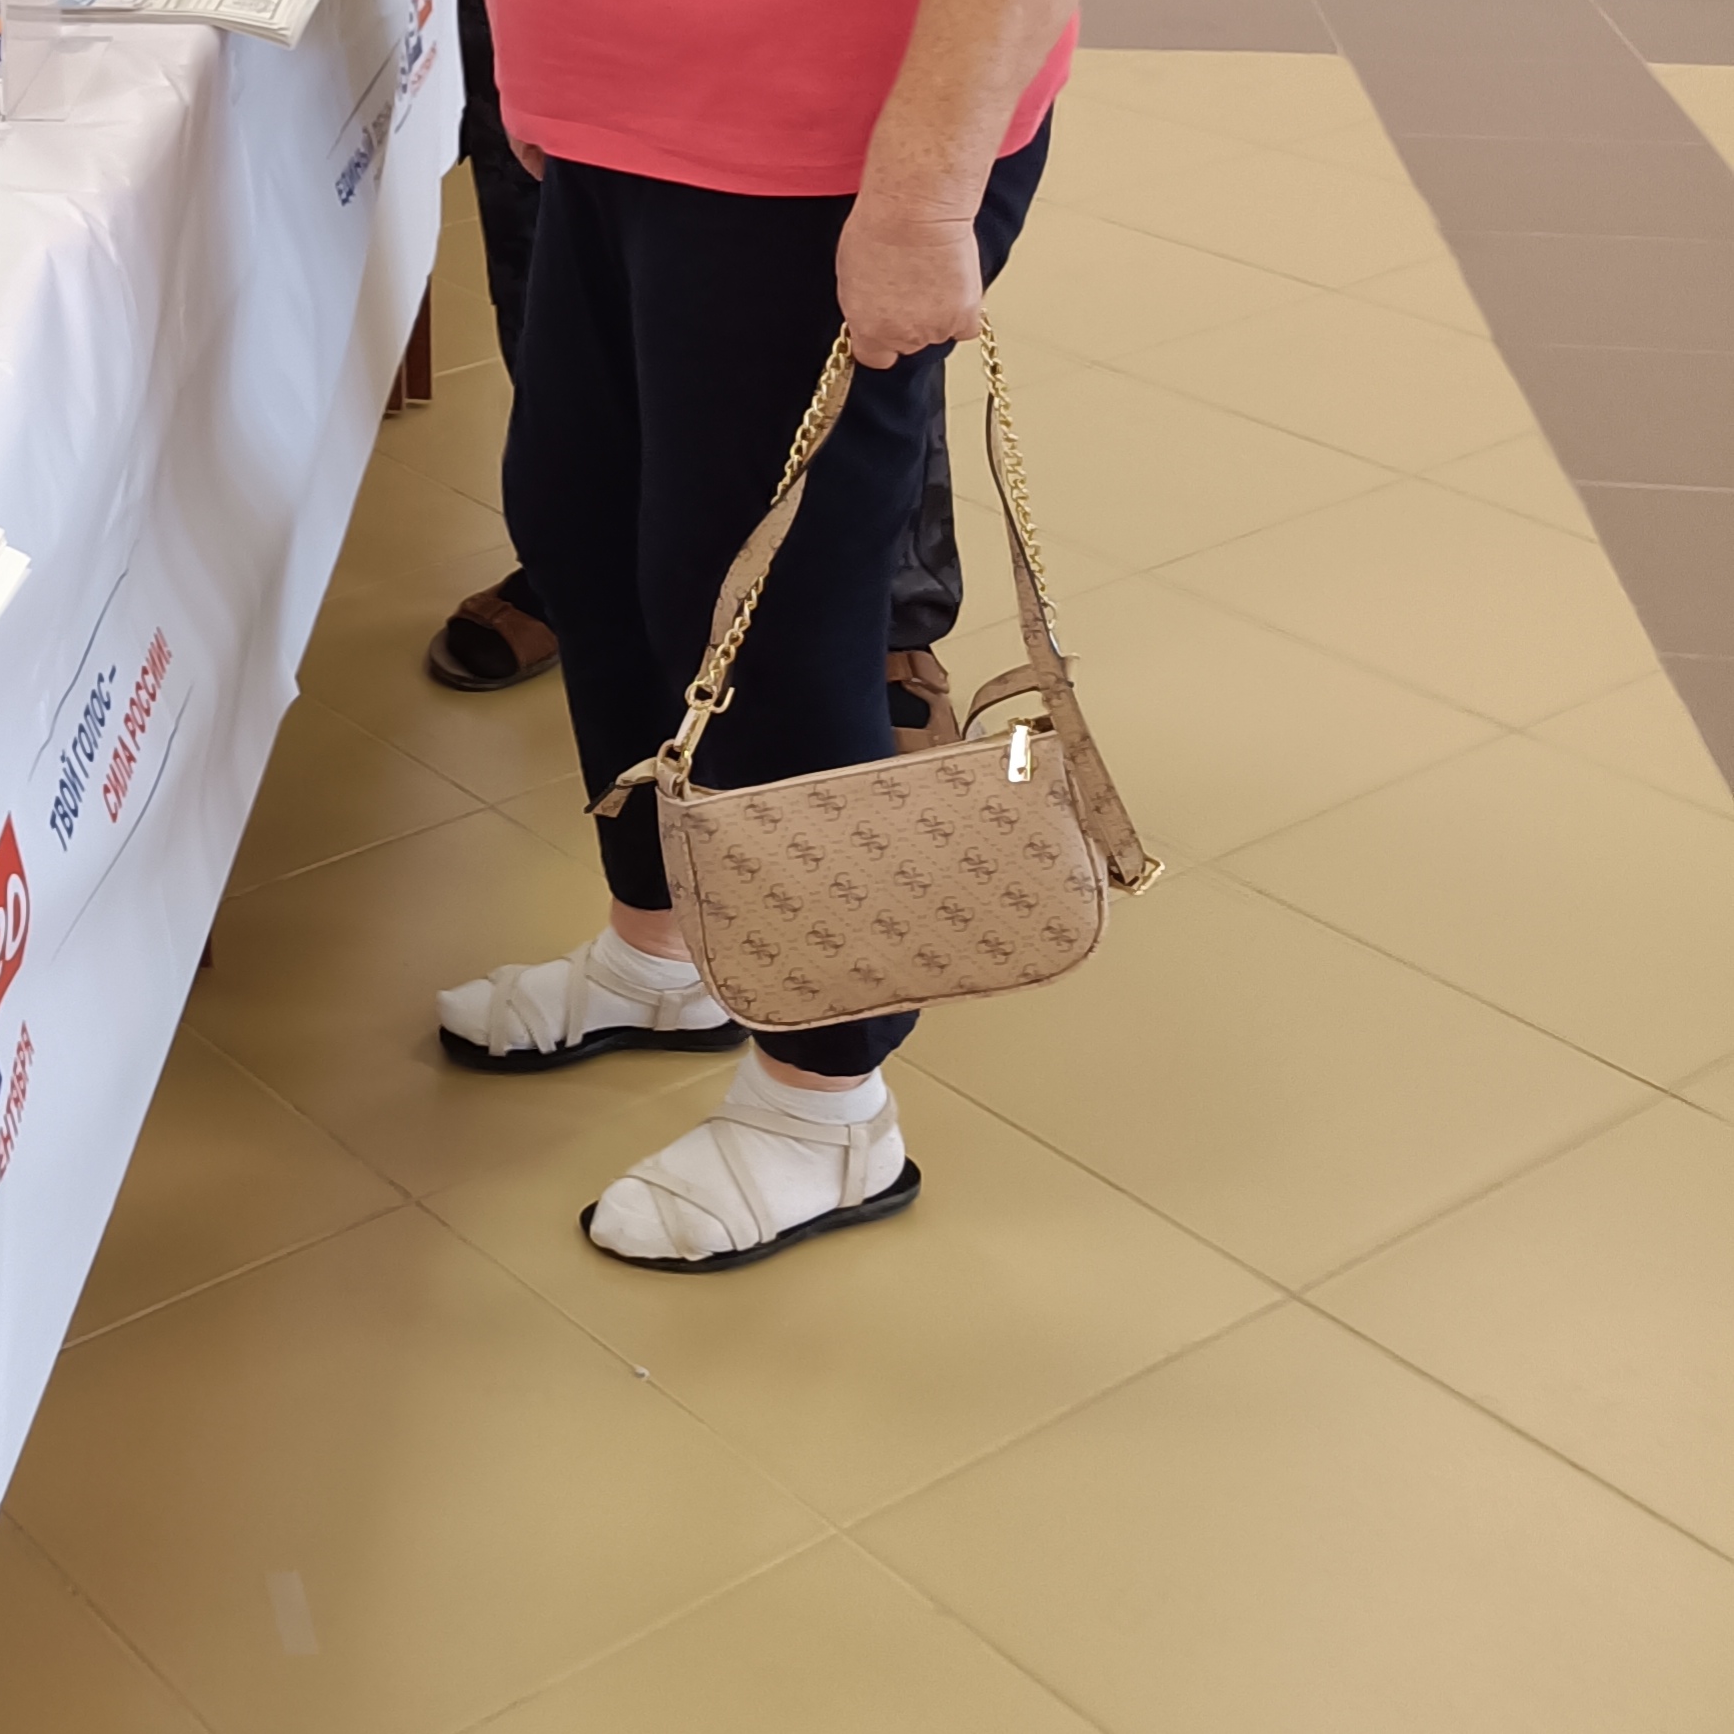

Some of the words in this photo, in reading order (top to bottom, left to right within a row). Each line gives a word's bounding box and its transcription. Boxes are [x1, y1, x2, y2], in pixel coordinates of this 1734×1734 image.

[50, 748, 86, 852] ТВОЙ
[73, 673, 112, 778] ГОЛОС
[102, 735, 138, 824] СИЛА
[123, 626, 173, 752] РОССИИ!
